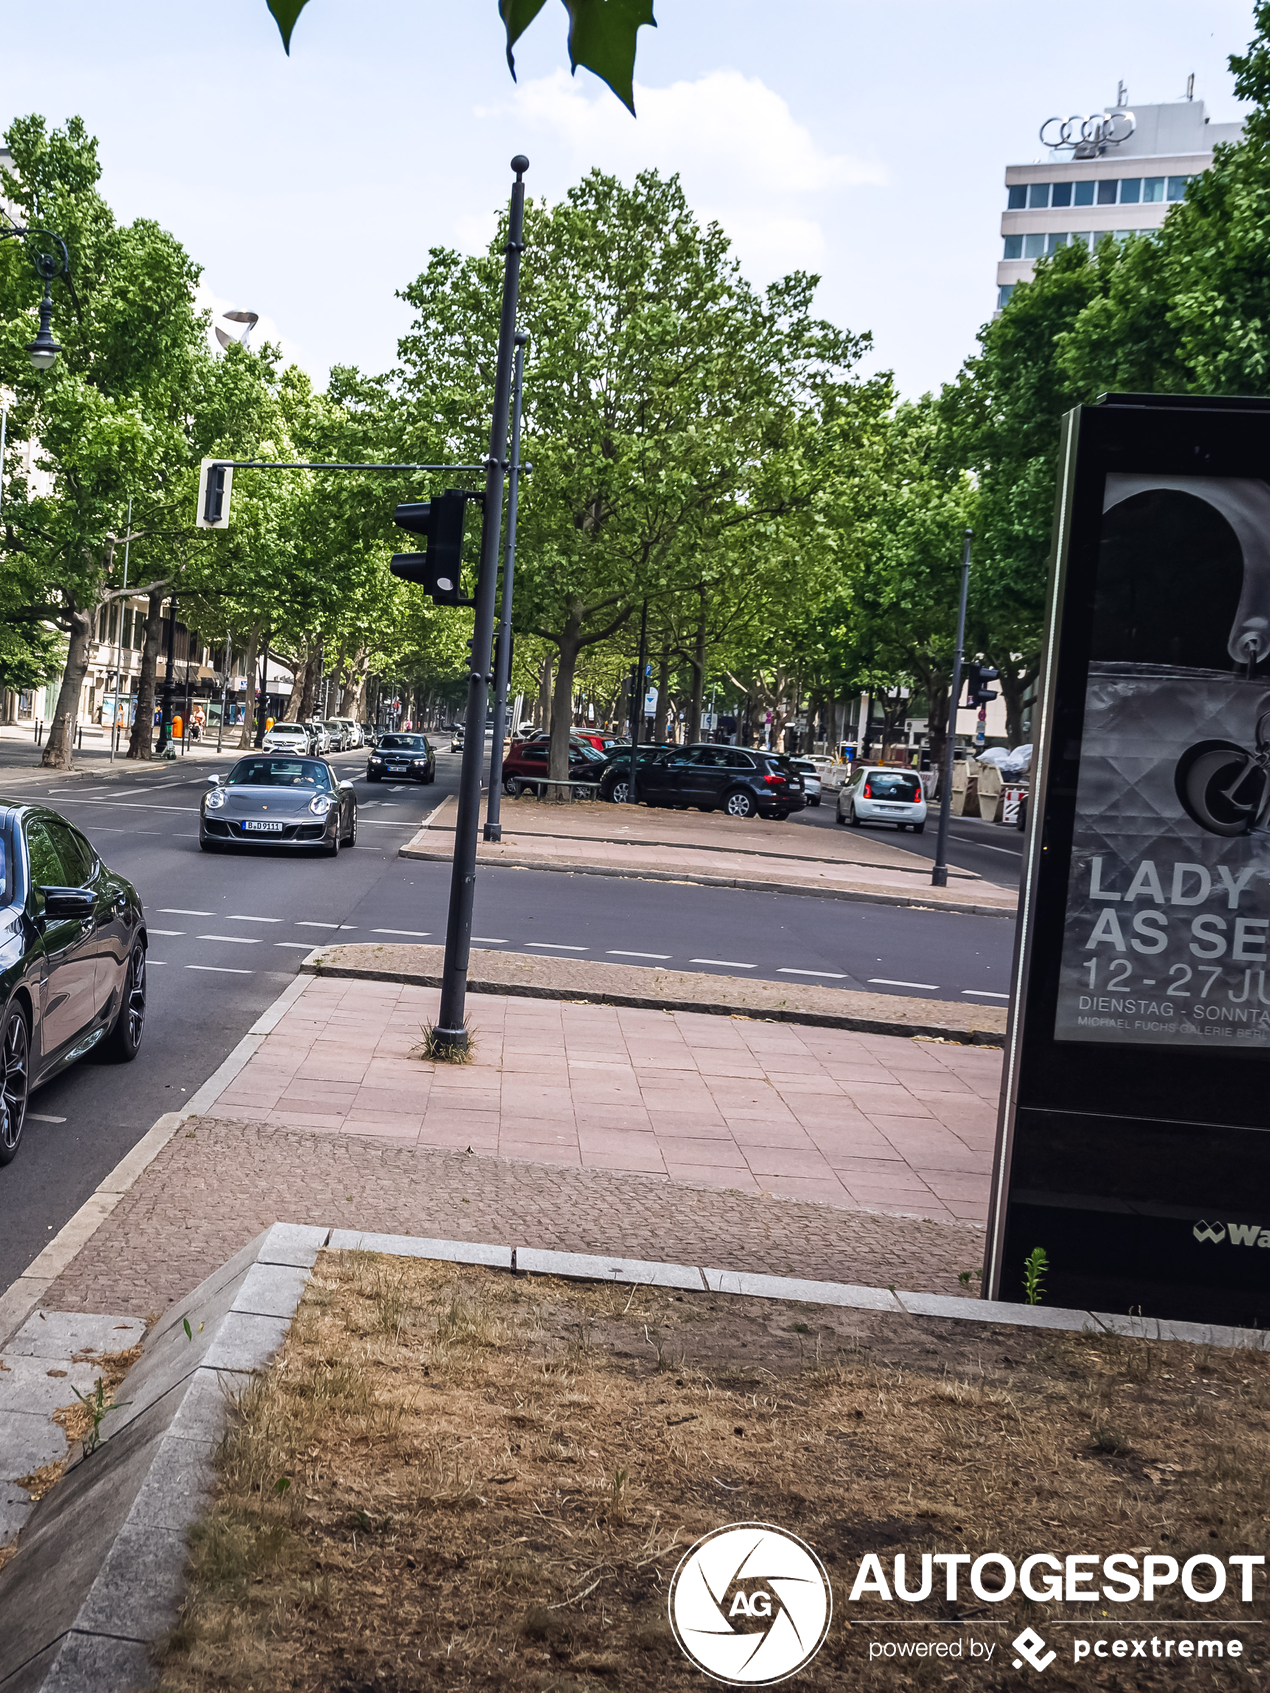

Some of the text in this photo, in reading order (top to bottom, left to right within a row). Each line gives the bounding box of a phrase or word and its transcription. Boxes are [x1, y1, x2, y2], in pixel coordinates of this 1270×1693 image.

[1089, 856, 1256, 909] LADY
[1085, 907, 1270, 961] AS SE
[1082, 956, 1133, 992] 12
[1142, 978, 1156, 986] -
[1166, 963, 1223, 998] 27
[1077, 1016, 1131, 1030] MICHAEL
[1134, 1020, 1177, 1033] FUCHS
[1180, 1024, 1233, 1037] GALERIE
[1079, 995, 1174, 1017] DIENSTAG
[1193, 1004, 1270, 1024] SONNTA
